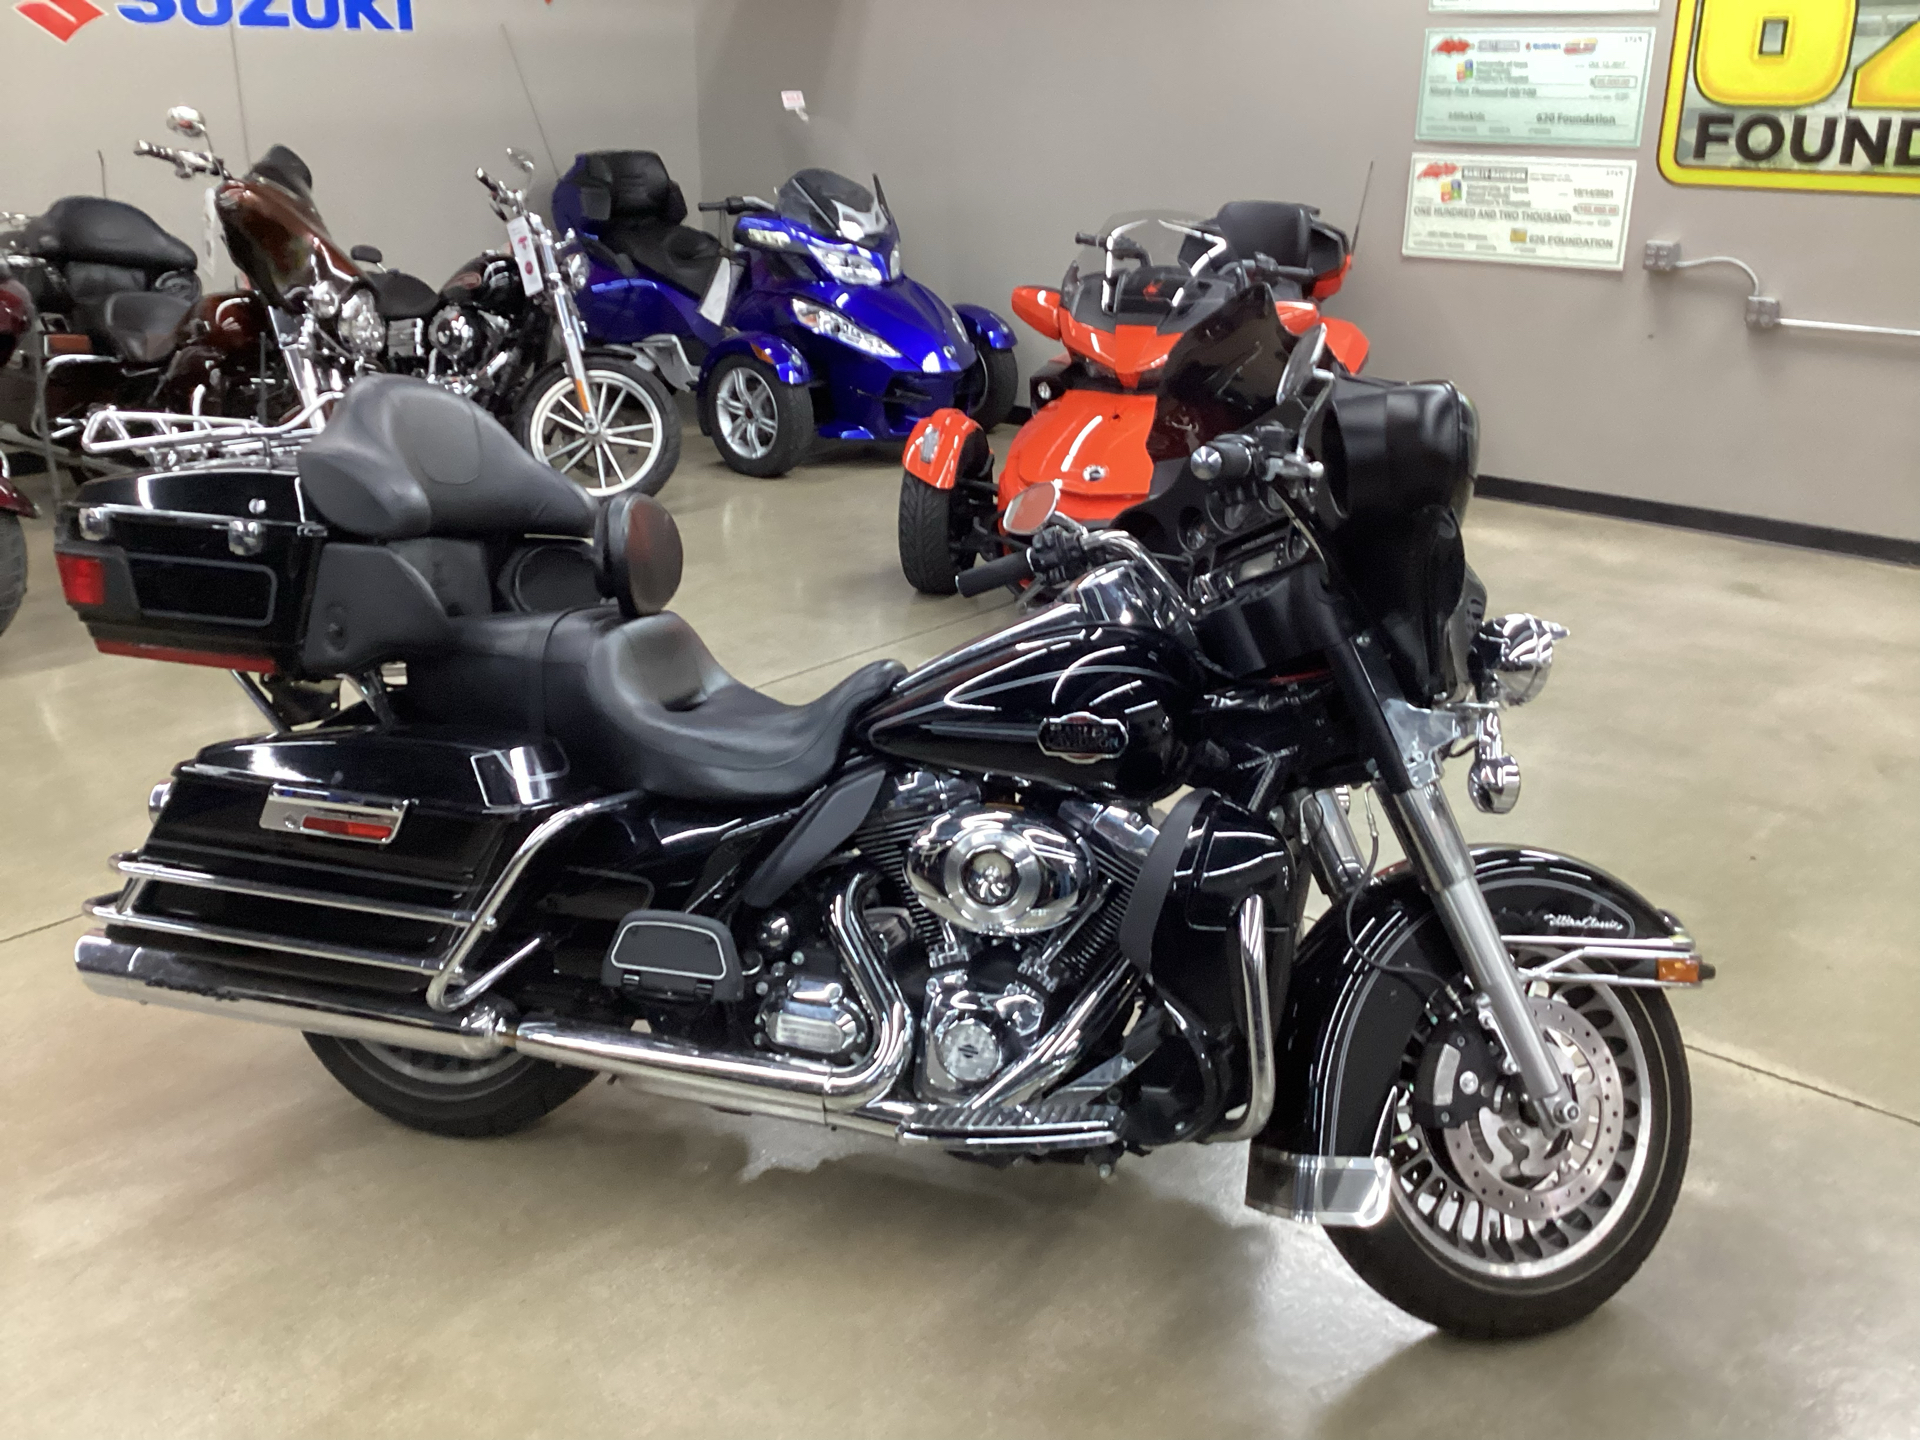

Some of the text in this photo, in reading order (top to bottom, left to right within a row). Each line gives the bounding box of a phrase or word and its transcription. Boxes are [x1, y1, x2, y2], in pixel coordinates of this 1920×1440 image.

[1557, 113, 1616, 126] Foundation
[1414, 207, 1432, 217] ONE
[1433, 207, 1476, 219] HUNDRED
[1477, 208, 1497, 220] AND
[1498, 209, 1520, 221] TWO
[1522, 211, 1572, 224] THOUSAND
[1548, 235, 1614, 249] FOUNDATION
